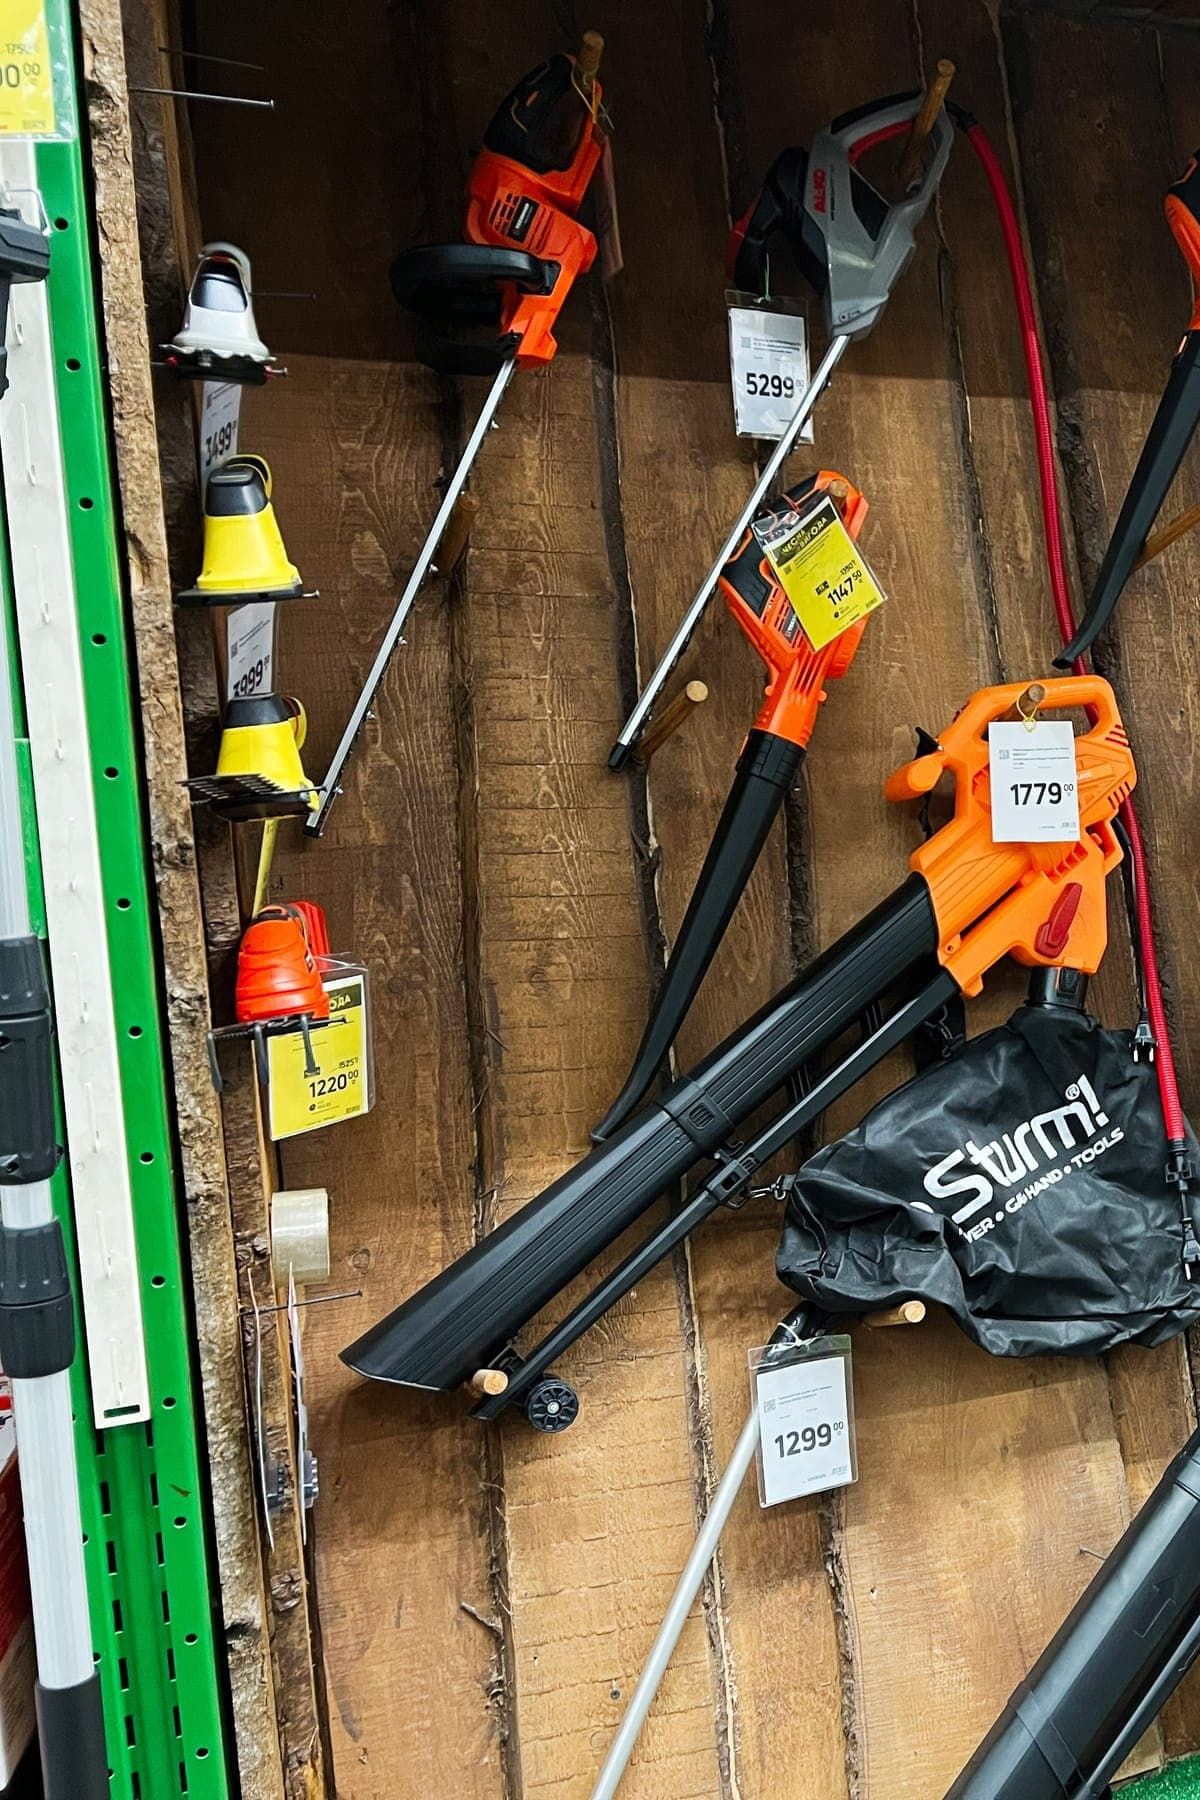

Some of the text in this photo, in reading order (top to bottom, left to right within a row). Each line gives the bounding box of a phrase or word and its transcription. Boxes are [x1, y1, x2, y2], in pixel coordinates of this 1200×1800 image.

[746, 372, 794, 399] 5299
[206, 421, 232, 466] 3499
[828, 576, 855, 606] 1147
[853, 570, 862, 581] 50
[1010, 782, 1074, 806] 1779 00
[309, 1069, 359, 1098] 1220 00
[923, 1074, 1110, 1225] Sturm!
[1070, 1126, 1125, 1169] TOOLS
[774, 1421, 844, 1459] 1299 00
